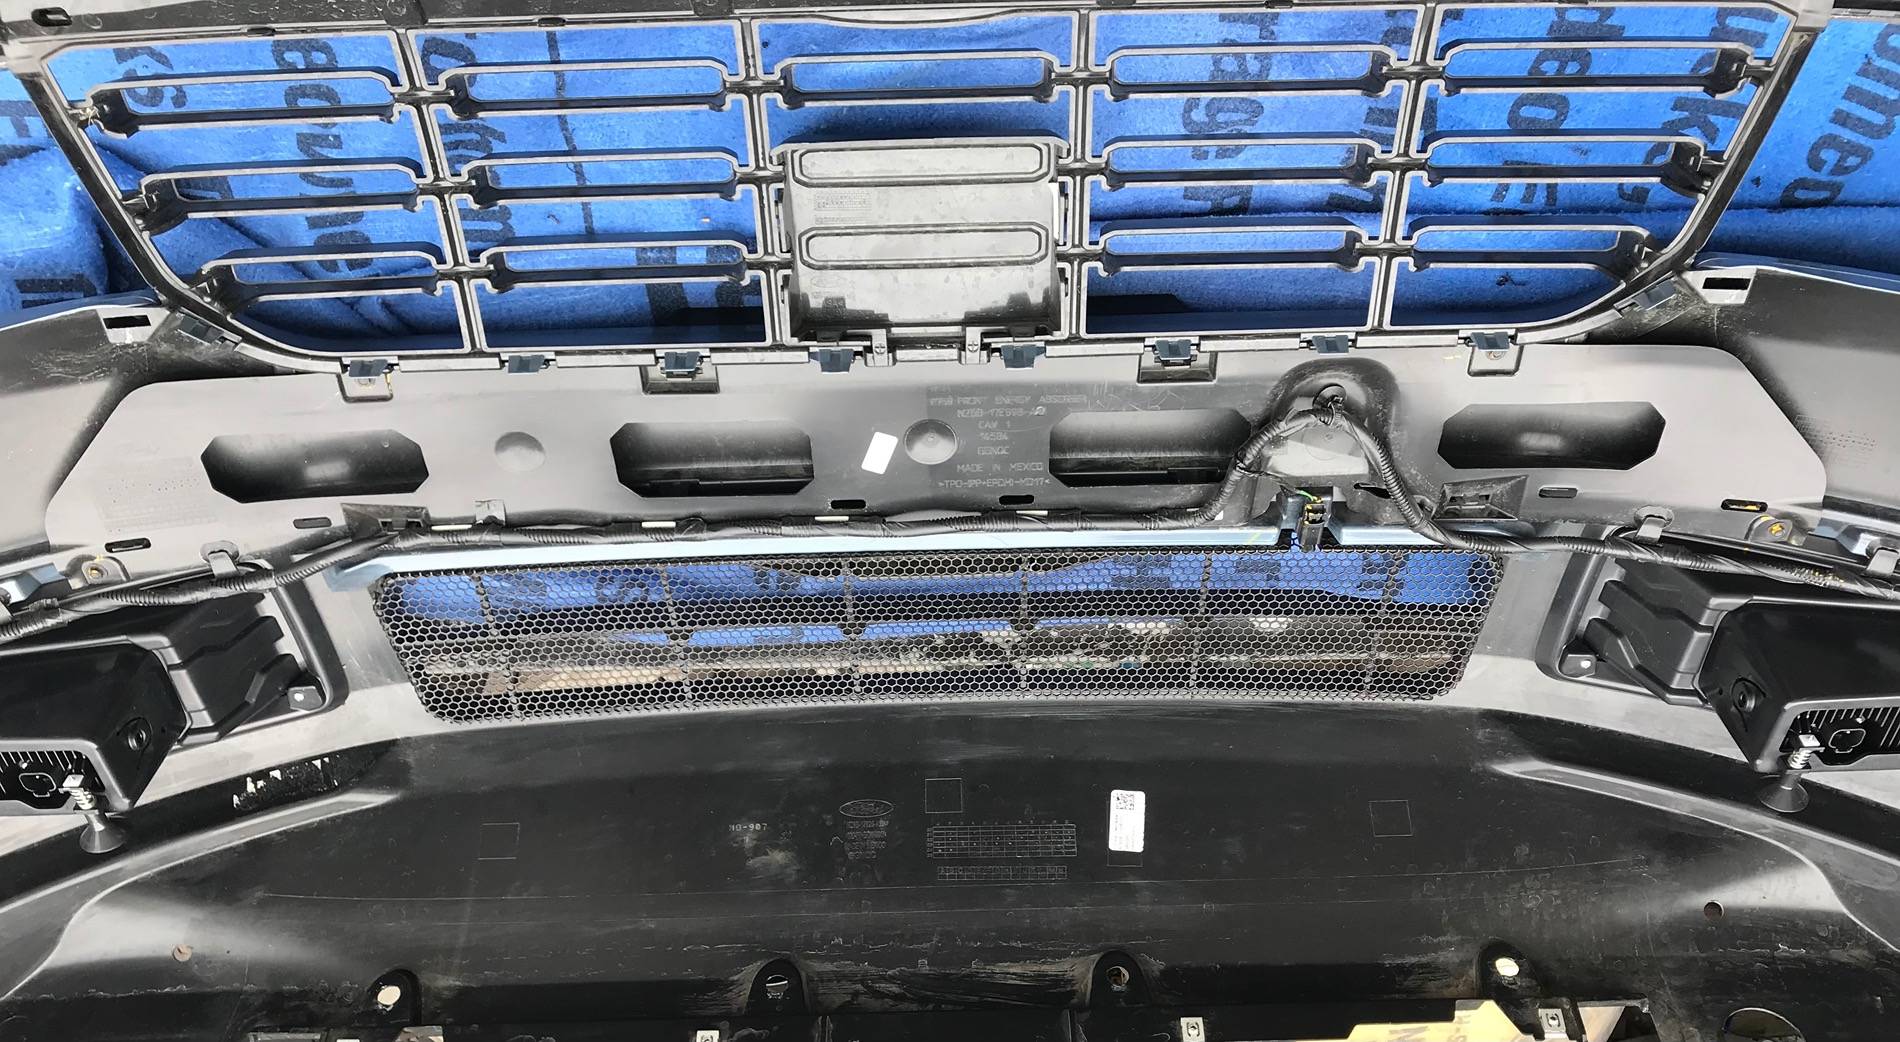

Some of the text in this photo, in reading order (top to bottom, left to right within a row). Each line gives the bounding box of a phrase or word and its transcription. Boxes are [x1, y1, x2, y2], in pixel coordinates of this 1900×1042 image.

[1039, 394, 1088, 404] ABSORBER
[978, 420, 998, 428] CAV
[957, 462, 1044, 473] MADE IN MEXICO
